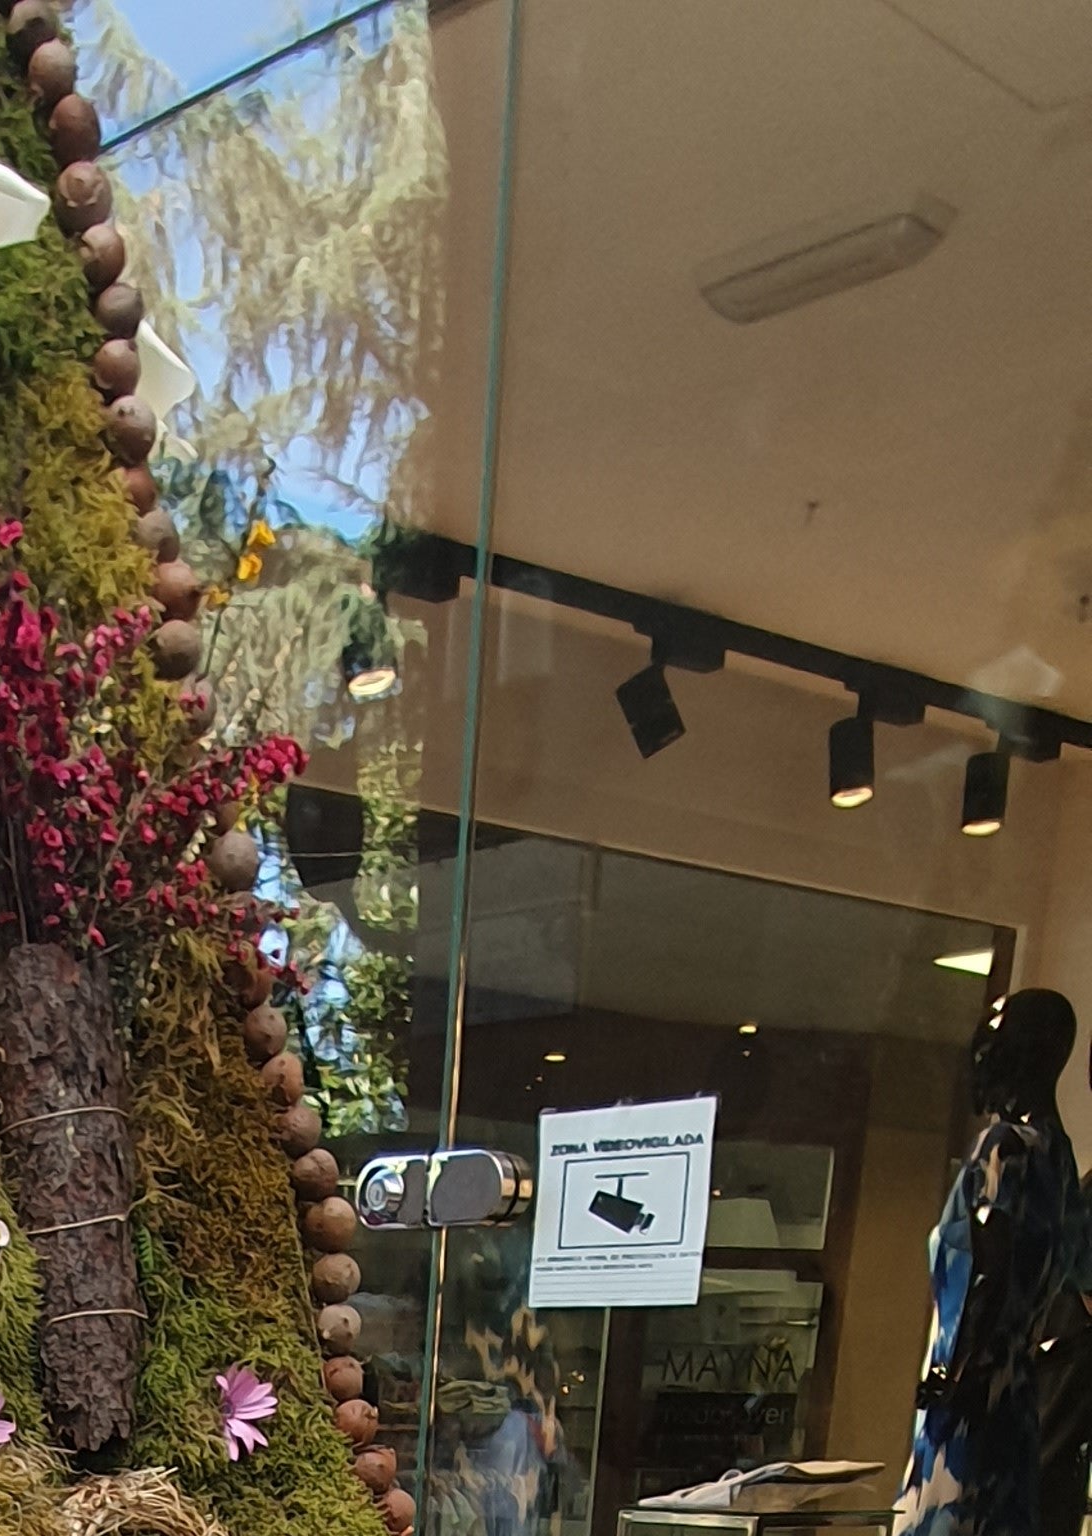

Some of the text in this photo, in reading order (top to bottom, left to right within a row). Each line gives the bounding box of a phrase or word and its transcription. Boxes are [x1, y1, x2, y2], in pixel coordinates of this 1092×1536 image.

[550, 1133, 704, 1156] ZONA VIDEOVIGILADA
[662, 1350, 797, 1383] MAYNA
